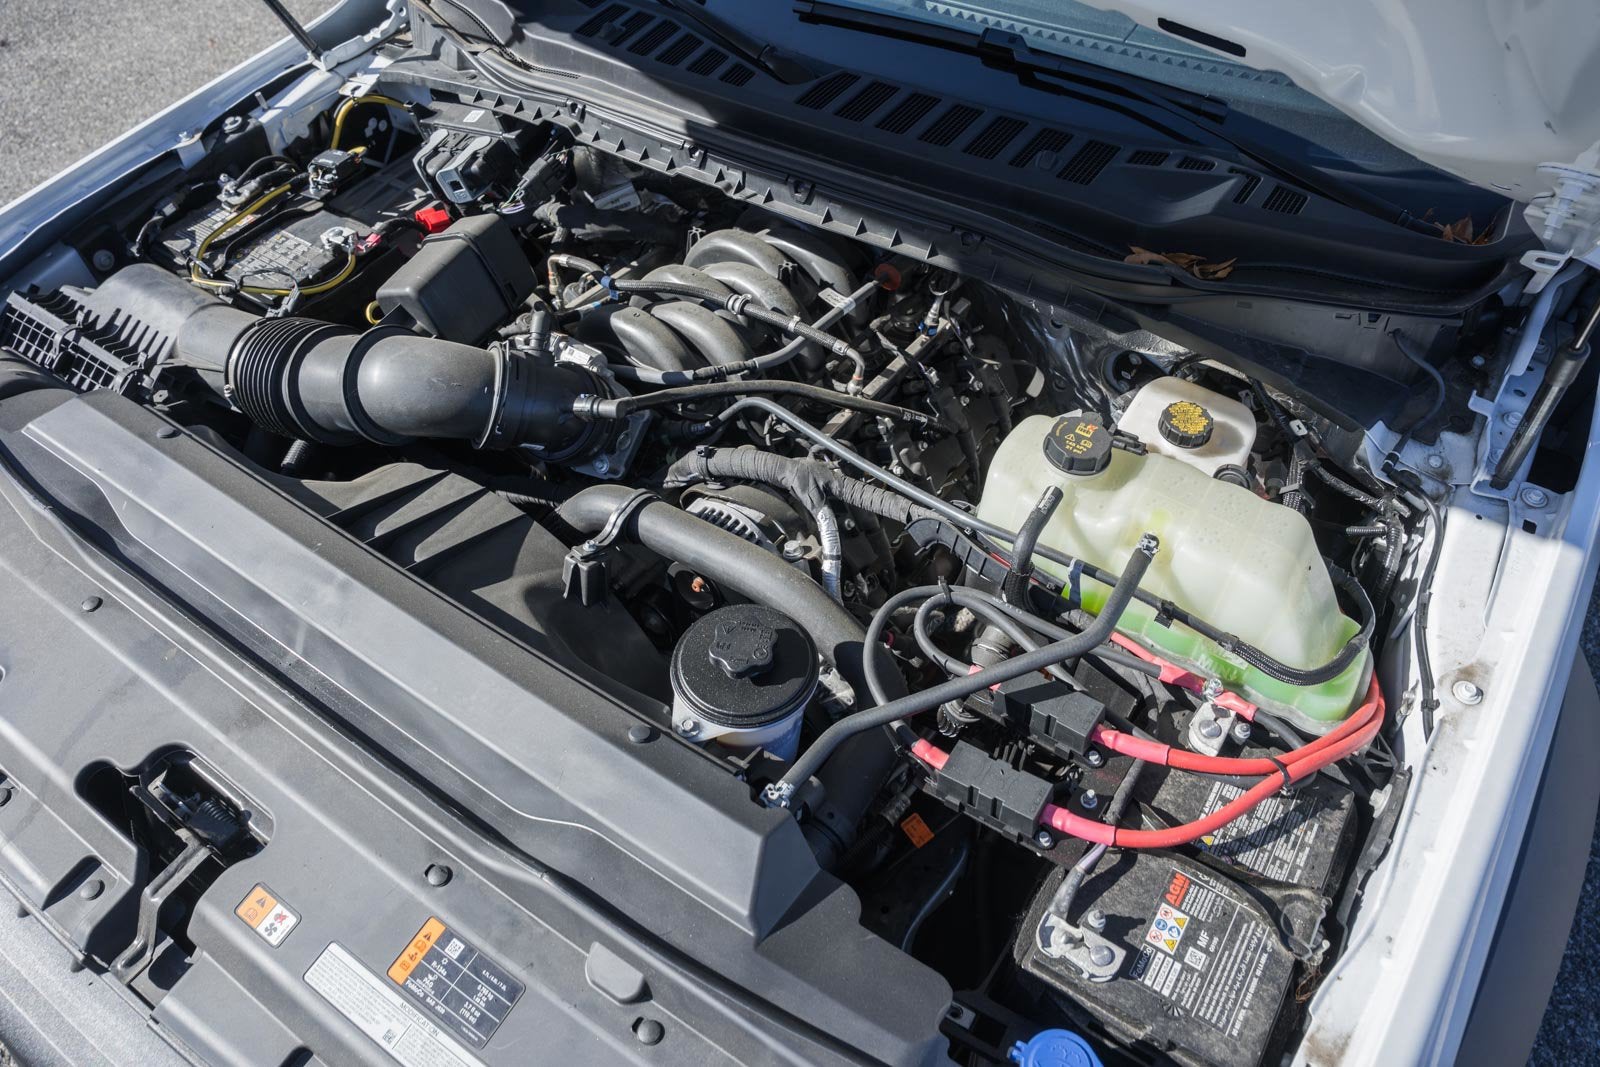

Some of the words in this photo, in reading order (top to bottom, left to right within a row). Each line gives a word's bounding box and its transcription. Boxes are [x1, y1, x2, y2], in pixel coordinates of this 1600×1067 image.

[1163, 871, 1187, 905] AGM
[1196, 929, 1211, 948] MF
[1132, 945, 1153, 979] FoMoCo
[398, 1001, 440, 1037] MODIFICATION
